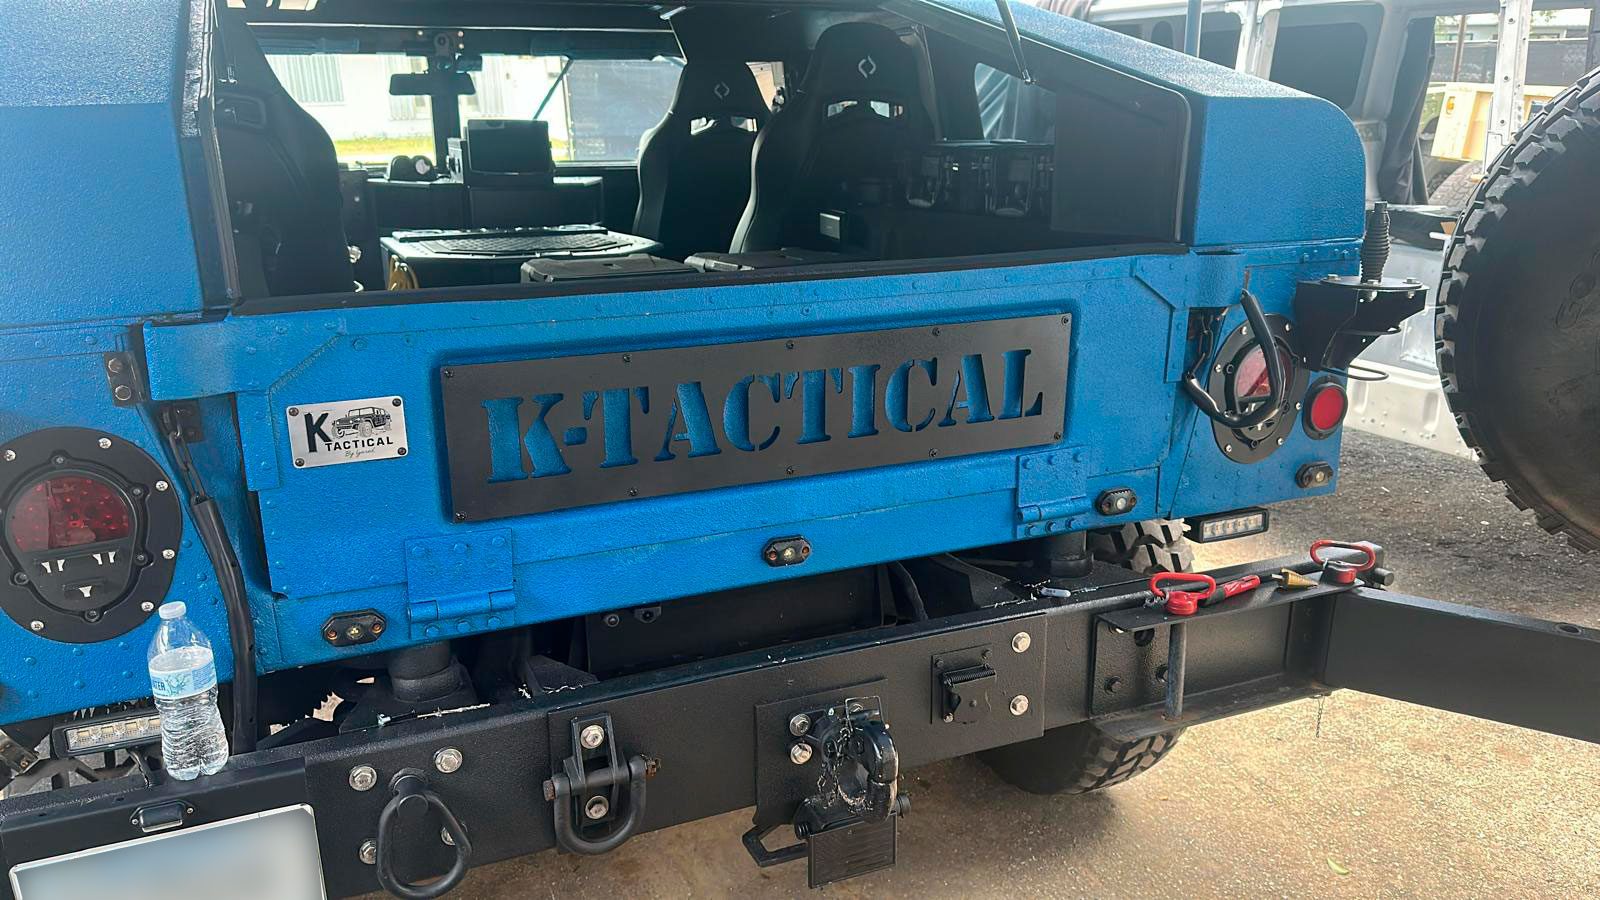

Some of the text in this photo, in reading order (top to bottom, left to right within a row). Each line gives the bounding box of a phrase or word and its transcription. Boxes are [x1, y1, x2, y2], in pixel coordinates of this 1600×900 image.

[304, 412, 393, 453] K TACTICAL
[481, 349, 1043, 484] K-TACTICAL
